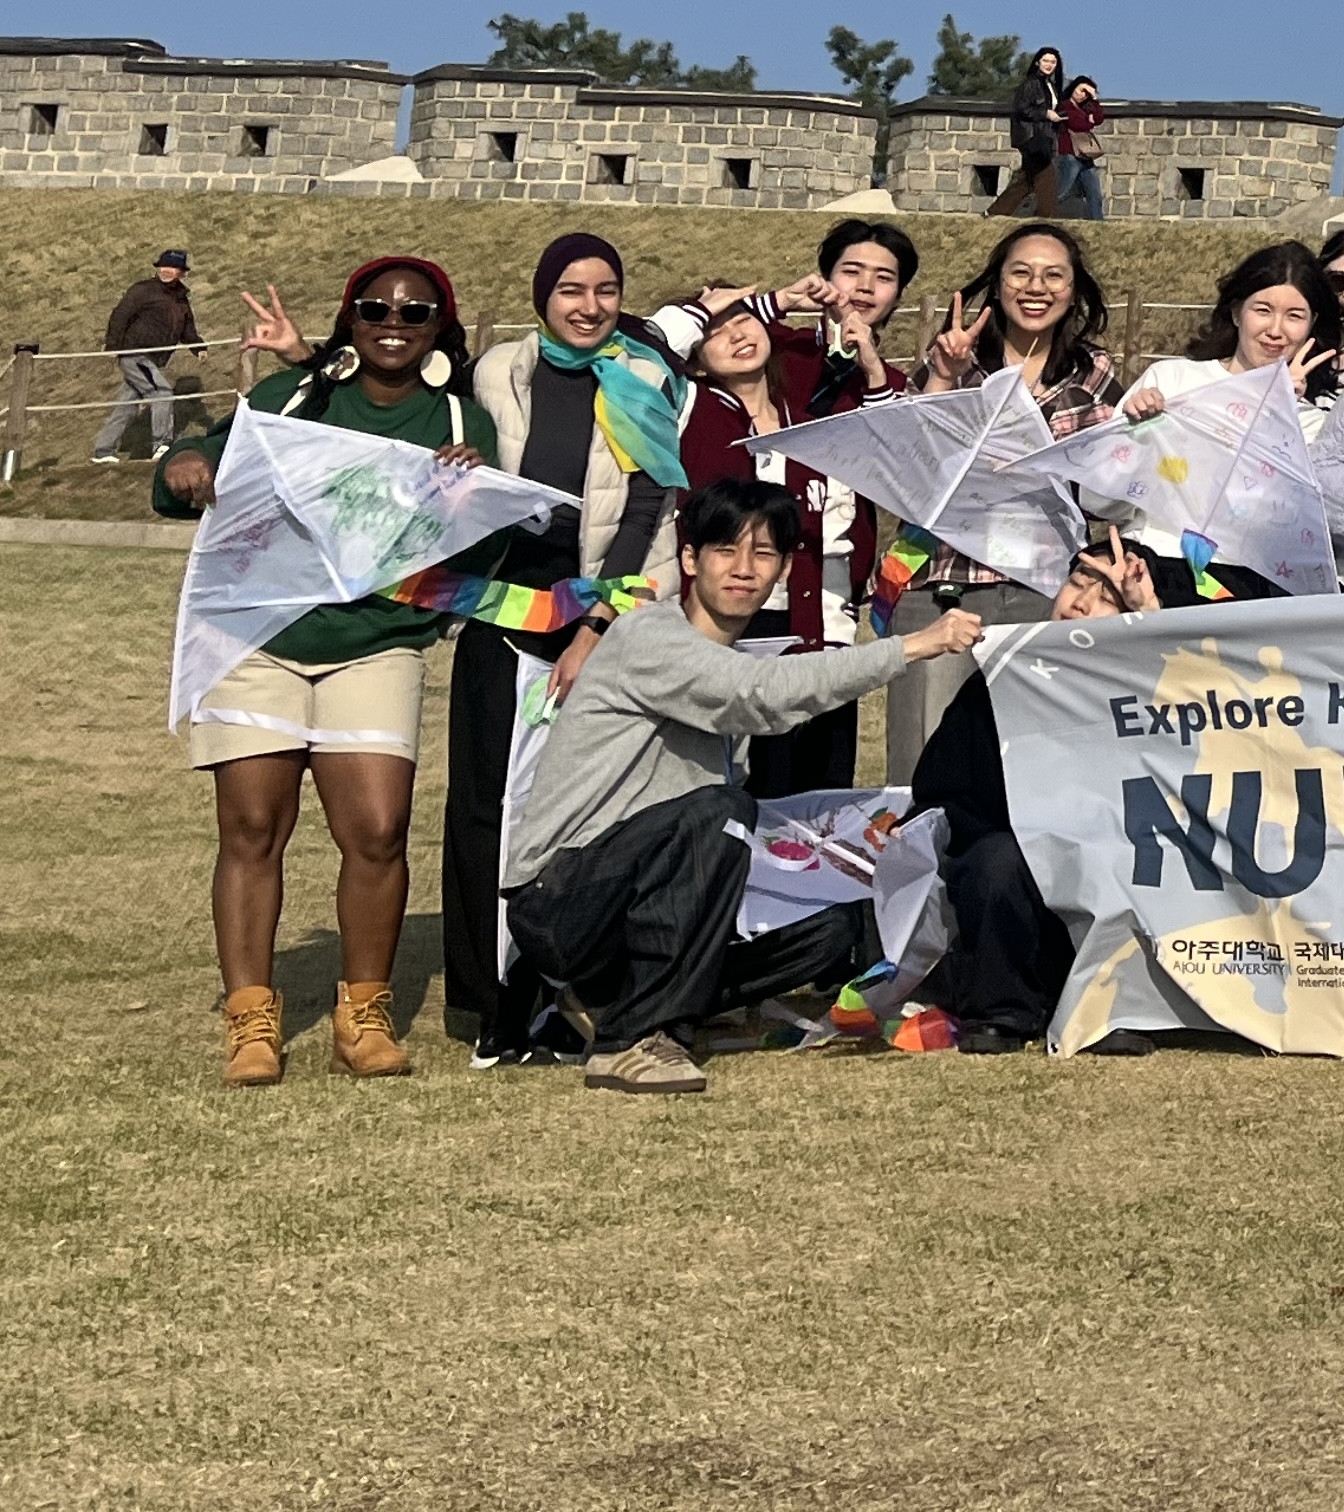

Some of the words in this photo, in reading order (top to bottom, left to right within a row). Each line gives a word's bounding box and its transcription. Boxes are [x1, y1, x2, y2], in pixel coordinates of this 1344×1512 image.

[1109, 689, 1305, 745] Explore
[1172, 940, 1285, 961] 아주대학교
[1172, 961, 1206, 974] AJOU
[1212, 962, 1285, 975] UNIVERSITY
